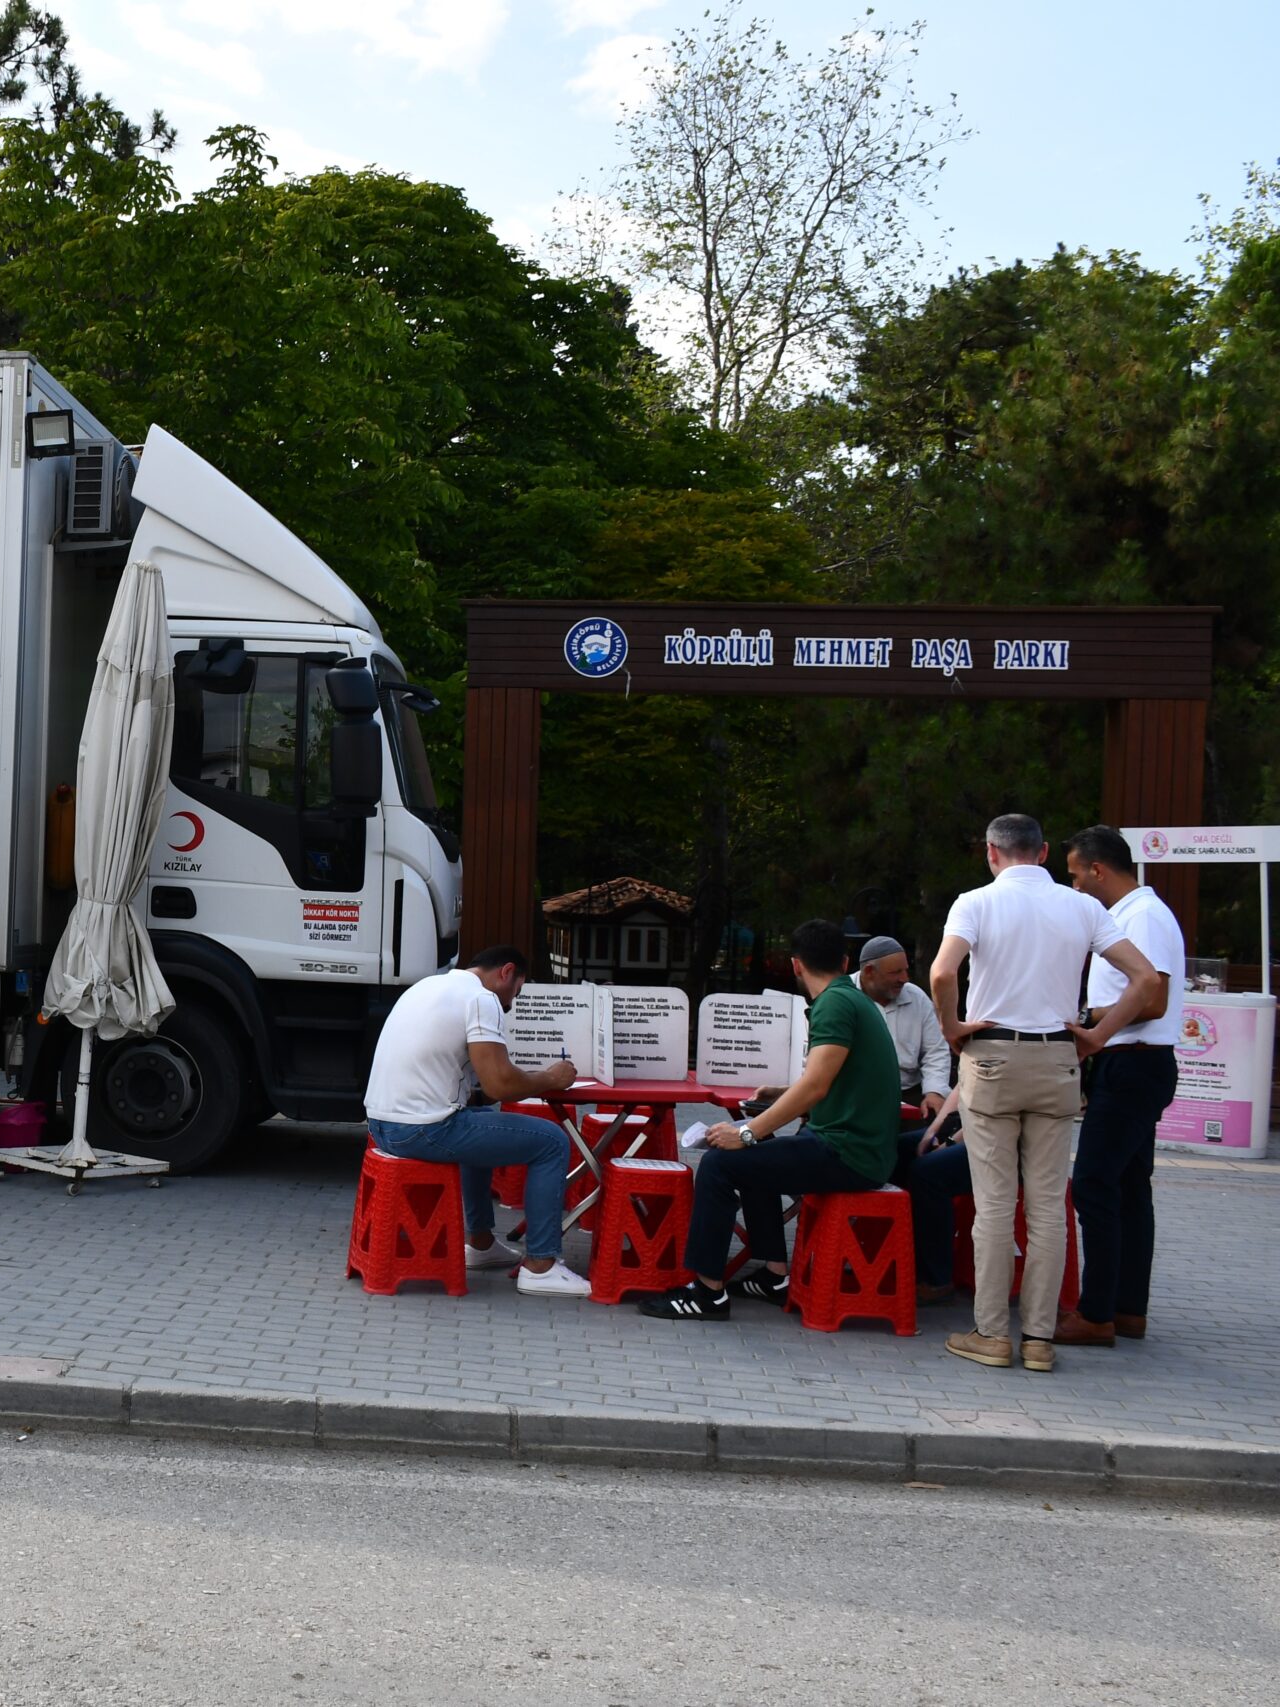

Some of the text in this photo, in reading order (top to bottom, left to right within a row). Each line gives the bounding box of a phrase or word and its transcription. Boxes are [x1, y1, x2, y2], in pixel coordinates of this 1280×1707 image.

[664, 628, 1069, 676] KÖPRÜLÜ MEHMET PAŞA PARKI
[163, 861, 202, 872] KIZILAY
[303, 908, 359, 918] DİKKAT KÖR NOKTA
[313, 923, 337, 931] ALANDA
[338, 924, 358, 932] ŞOFÖR
[309, 932, 321, 941] SİZİ
